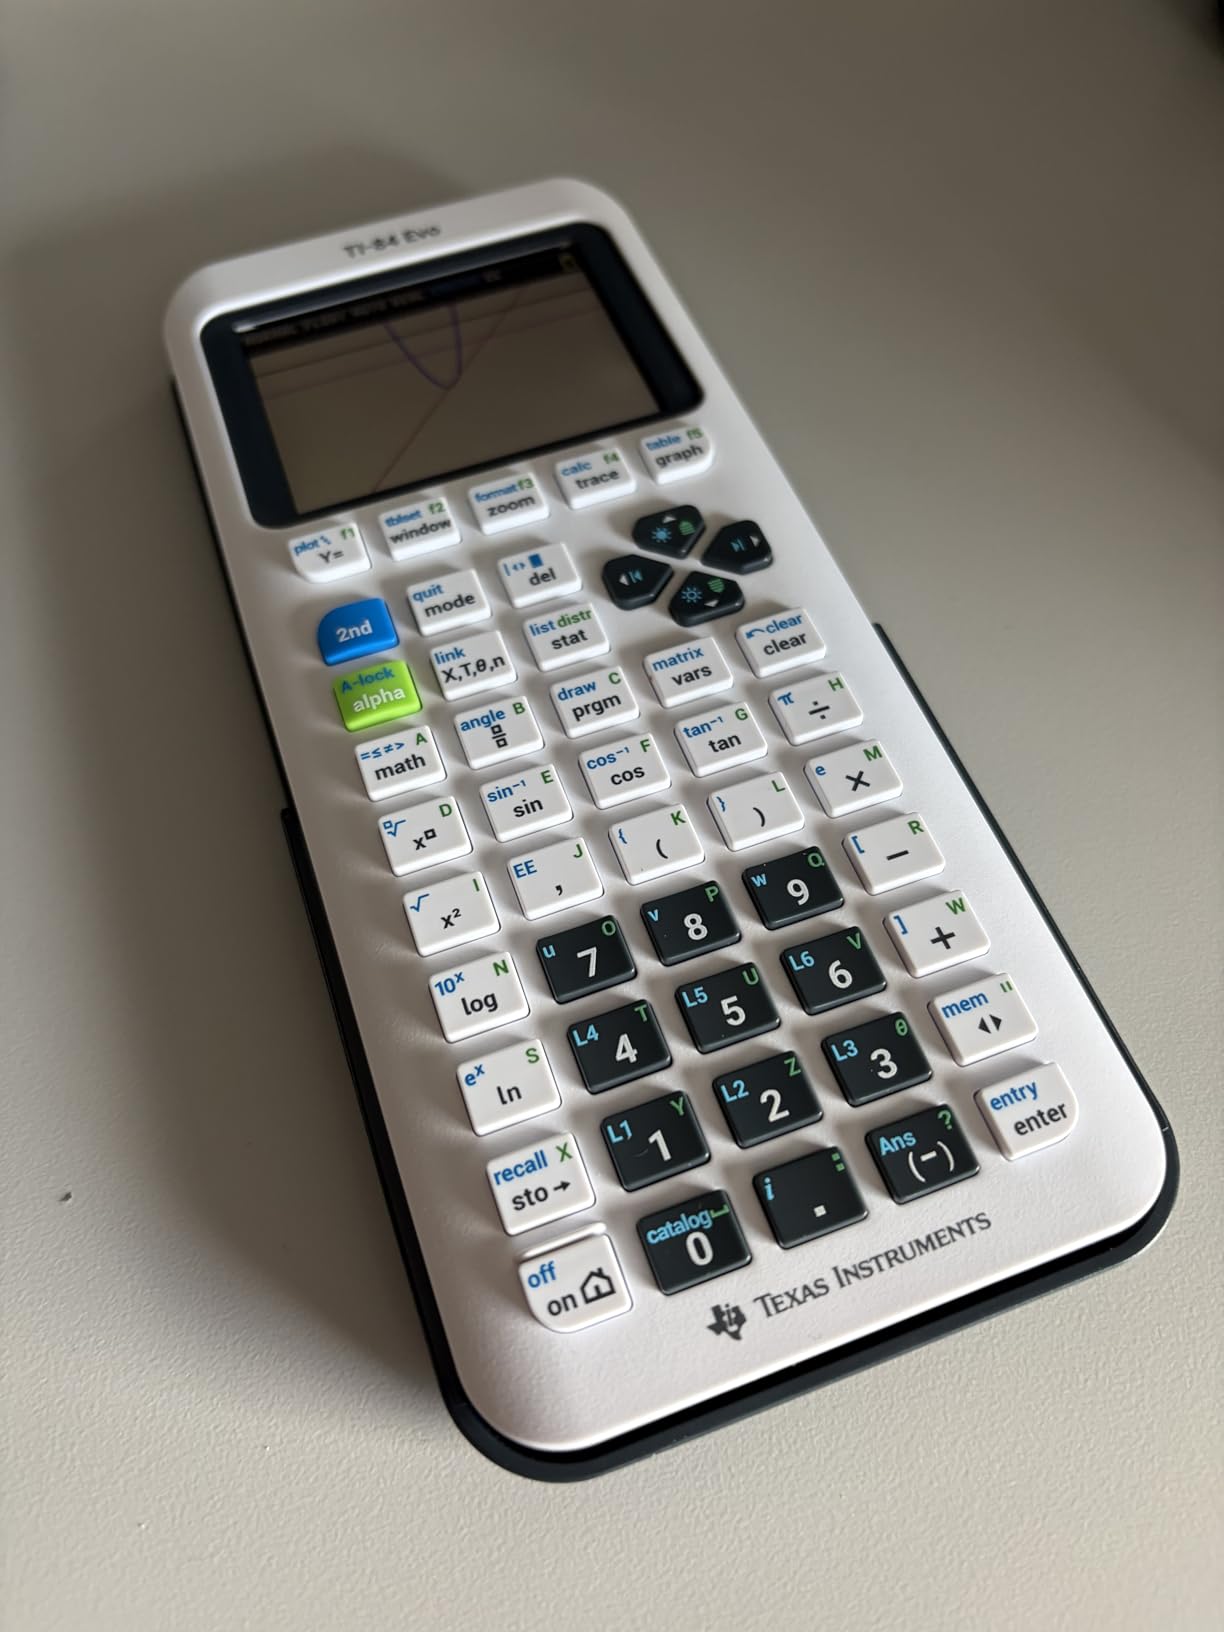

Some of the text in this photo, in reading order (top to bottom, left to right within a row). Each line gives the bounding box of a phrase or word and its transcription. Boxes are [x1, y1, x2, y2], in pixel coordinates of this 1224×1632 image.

[603, 452, 620, 464] f4
[656, 445, 703, 469] graph
[562, 461, 592, 476] calc
[518, 478, 534, 491] f3
[576, 470, 619, 489] trace
[428, 503, 445, 515] f2
[488, 495, 536, 517] zoom
[340, 528, 354, 540] f1
[390, 518, 451, 543] window
[320, 550, 344, 564] Y=
[529, 568, 556, 587] del
[412, 584, 444, 603] quit
[425, 593, 475, 617] mode
[336, 620, 373, 642] 2nd
[529, 609, 593, 637] list distr
[766, 615, 802, 634] clear
[552, 630, 588, 650] stat
[764, 633, 807, 655] clear
[434, 646, 465, 664] link
[653, 647, 704, 671] matrix
[342, 667, 394, 693] A-lock
[608, 672, 622, 685] C
[672, 665, 712, 686] vars
[828, 677, 845, 691] H
[353, 686, 405, 712] alpha
[558, 682, 596, 701] draw
[512, 702, 525, 715] B
[572, 694, 622, 722] prgm
[735, 708, 749, 721] G
[460, 709, 506, 733] angle
[415, 733, 427, 745] A
[640, 739, 651, 752] F
[709, 734, 741, 753] tan
[863, 745, 883, 761] M
[375, 754, 426, 780] math
[541, 770, 553, 784] E
[611, 766, 645, 785] cos
[815, 765, 826, 776] e
[771, 780, 785, 792] L
[439, 804, 452, 817] D
[513, 798, 544, 817] sin
[670, 811, 686, 825] K
[907, 820, 924, 835] R
[573, 843, 583, 858] J
[807, 853, 825, 868] Q
[513, 859, 537, 879] EE
[705, 885, 719, 902] P
[787, 879, 809, 905] 9
[945, 897, 967, 915] W
[684, 913, 708, 940] 8
[542, 944, 556, 958] u
[846, 932, 861, 950] V
[492, 960, 510, 976] N
[576, 946, 597, 978] 7
[789, 950, 815, 971] L6
[742, 968, 759, 985] U
[828, 960, 853, 989] 6
[461, 993, 498, 1015] log
[682, 986, 708, 1008] L5
[941, 992, 989, 1018] mem
[634, 1004, 648, 1022] T
[720, 996, 746, 1026] 5
[573, 1024, 599, 1047] L4
[526, 1048, 540, 1063] S
[616, 1033, 638, 1063] 4
[831, 1040, 858, 1061] L3
[784, 1058, 801, 1076] Z
[870, 1048, 898, 1079] 3
[497, 1085, 522, 1105] ln
[721, 1080, 750, 1103] L2
[990, 1081, 1038, 1110] entry
[670, 1098, 684, 1116] Y
[760, 1089, 790, 1122] 2
[938, 1110, 953, 1130] ?
[1014, 1103, 1068, 1136] enter
[607, 1120, 633, 1143] L1
[556, 1142, 573, 1162] X
[649, 1129, 672, 1161] 1
[879, 1131, 916, 1156] Ans
[493, 1150, 548, 1185] recall
[512, 1185, 548, 1211] sto
[764, 1177, 775, 1200] i
[646, 1209, 712, 1244] catalog
[686, 1231, 714, 1266] 0
[527, 1260, 556, 1288] off
[753, 1212, 992, 1318] TEXAS INSTRUMENTS
[547, 1293, 578, 1316] on
